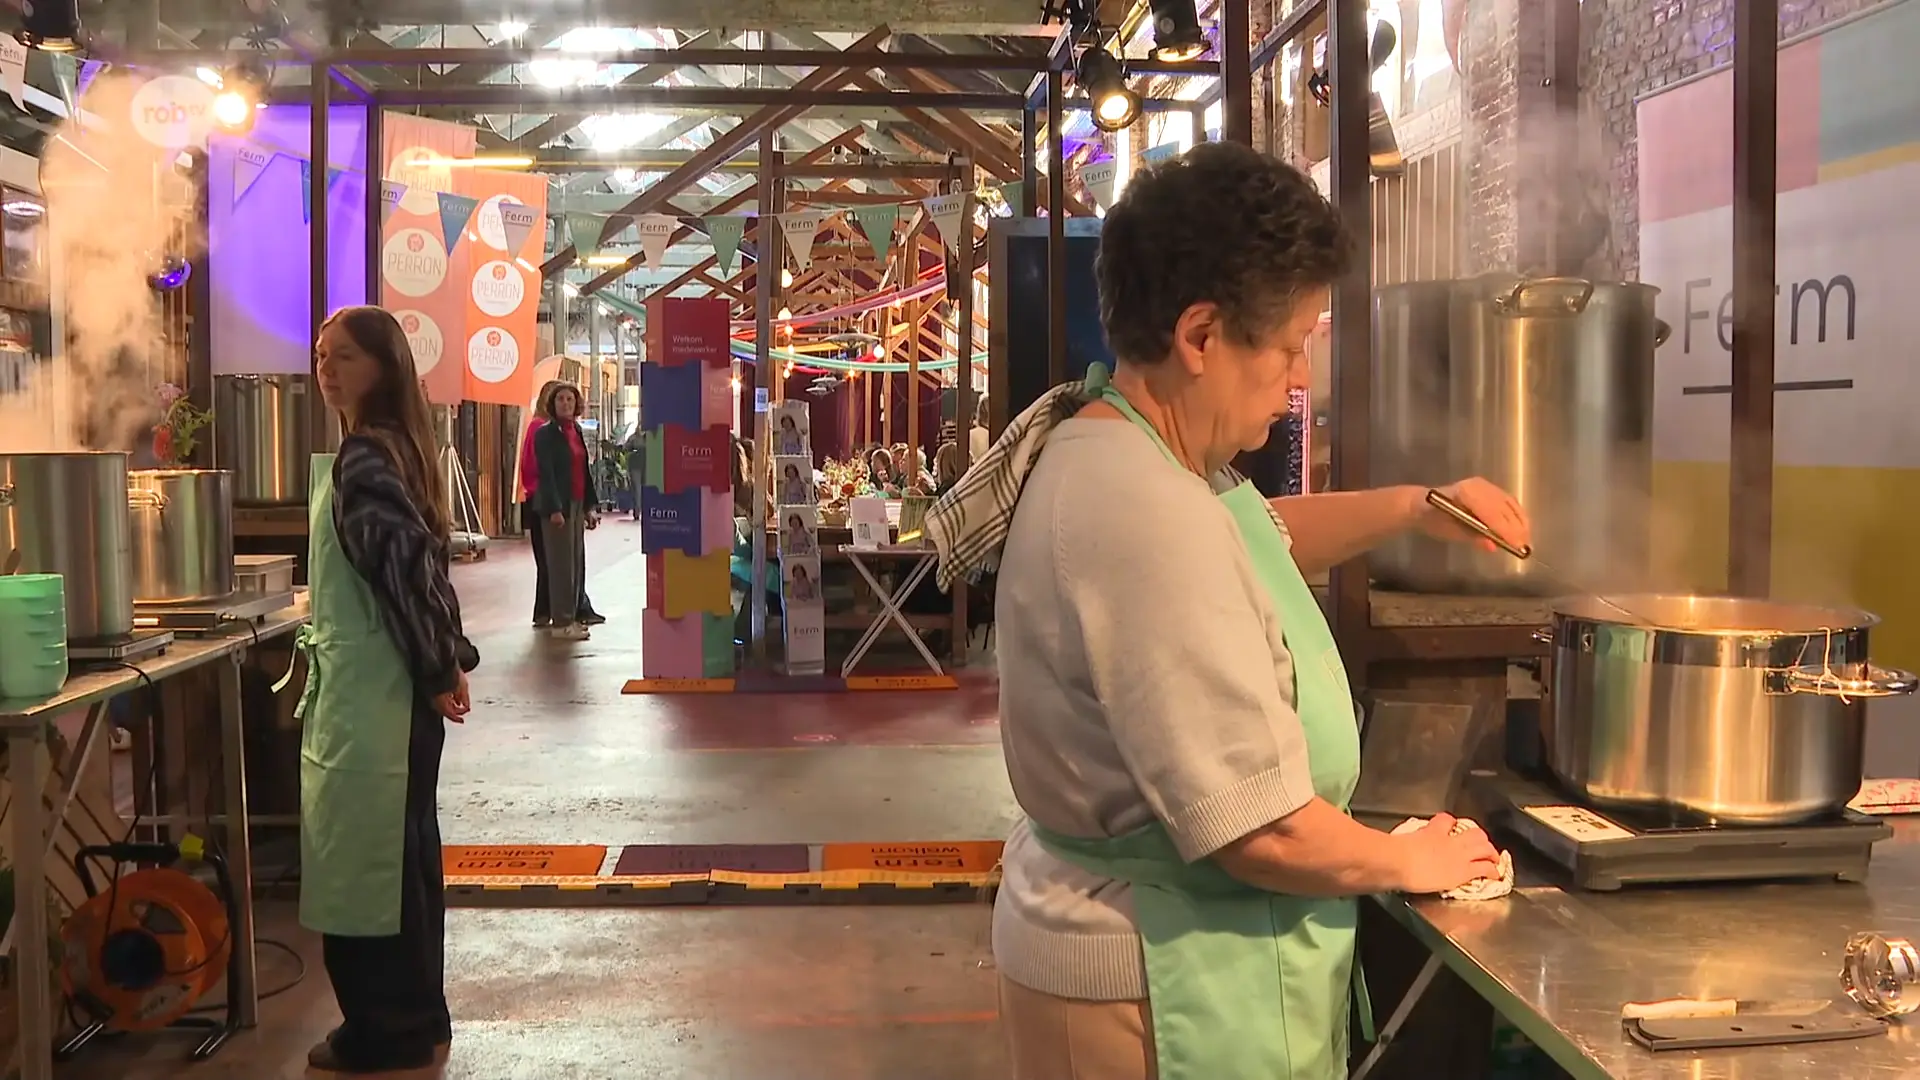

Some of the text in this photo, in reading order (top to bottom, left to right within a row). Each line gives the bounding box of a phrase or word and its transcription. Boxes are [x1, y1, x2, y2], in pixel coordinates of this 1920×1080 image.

[1085, 167, 1112, 181] Ferm
[931, 199, 960, 214] Ferm
[504, 210, 533, 224] Ferm
[640, 221, 668, 234] Ferm
[785, 219, 814, 230] Ferm
[387, 252, 442, 277] PERRON
[476, 279, 521, 300] PERRON
[471, 346, 515, 367] PERRON
[681, 445, 712, 457] Ferm
[650, 507, 678, 519] Ferm
[457, 861, 549, 869] Ferm
[874, 858, 964, 867] Ferm
